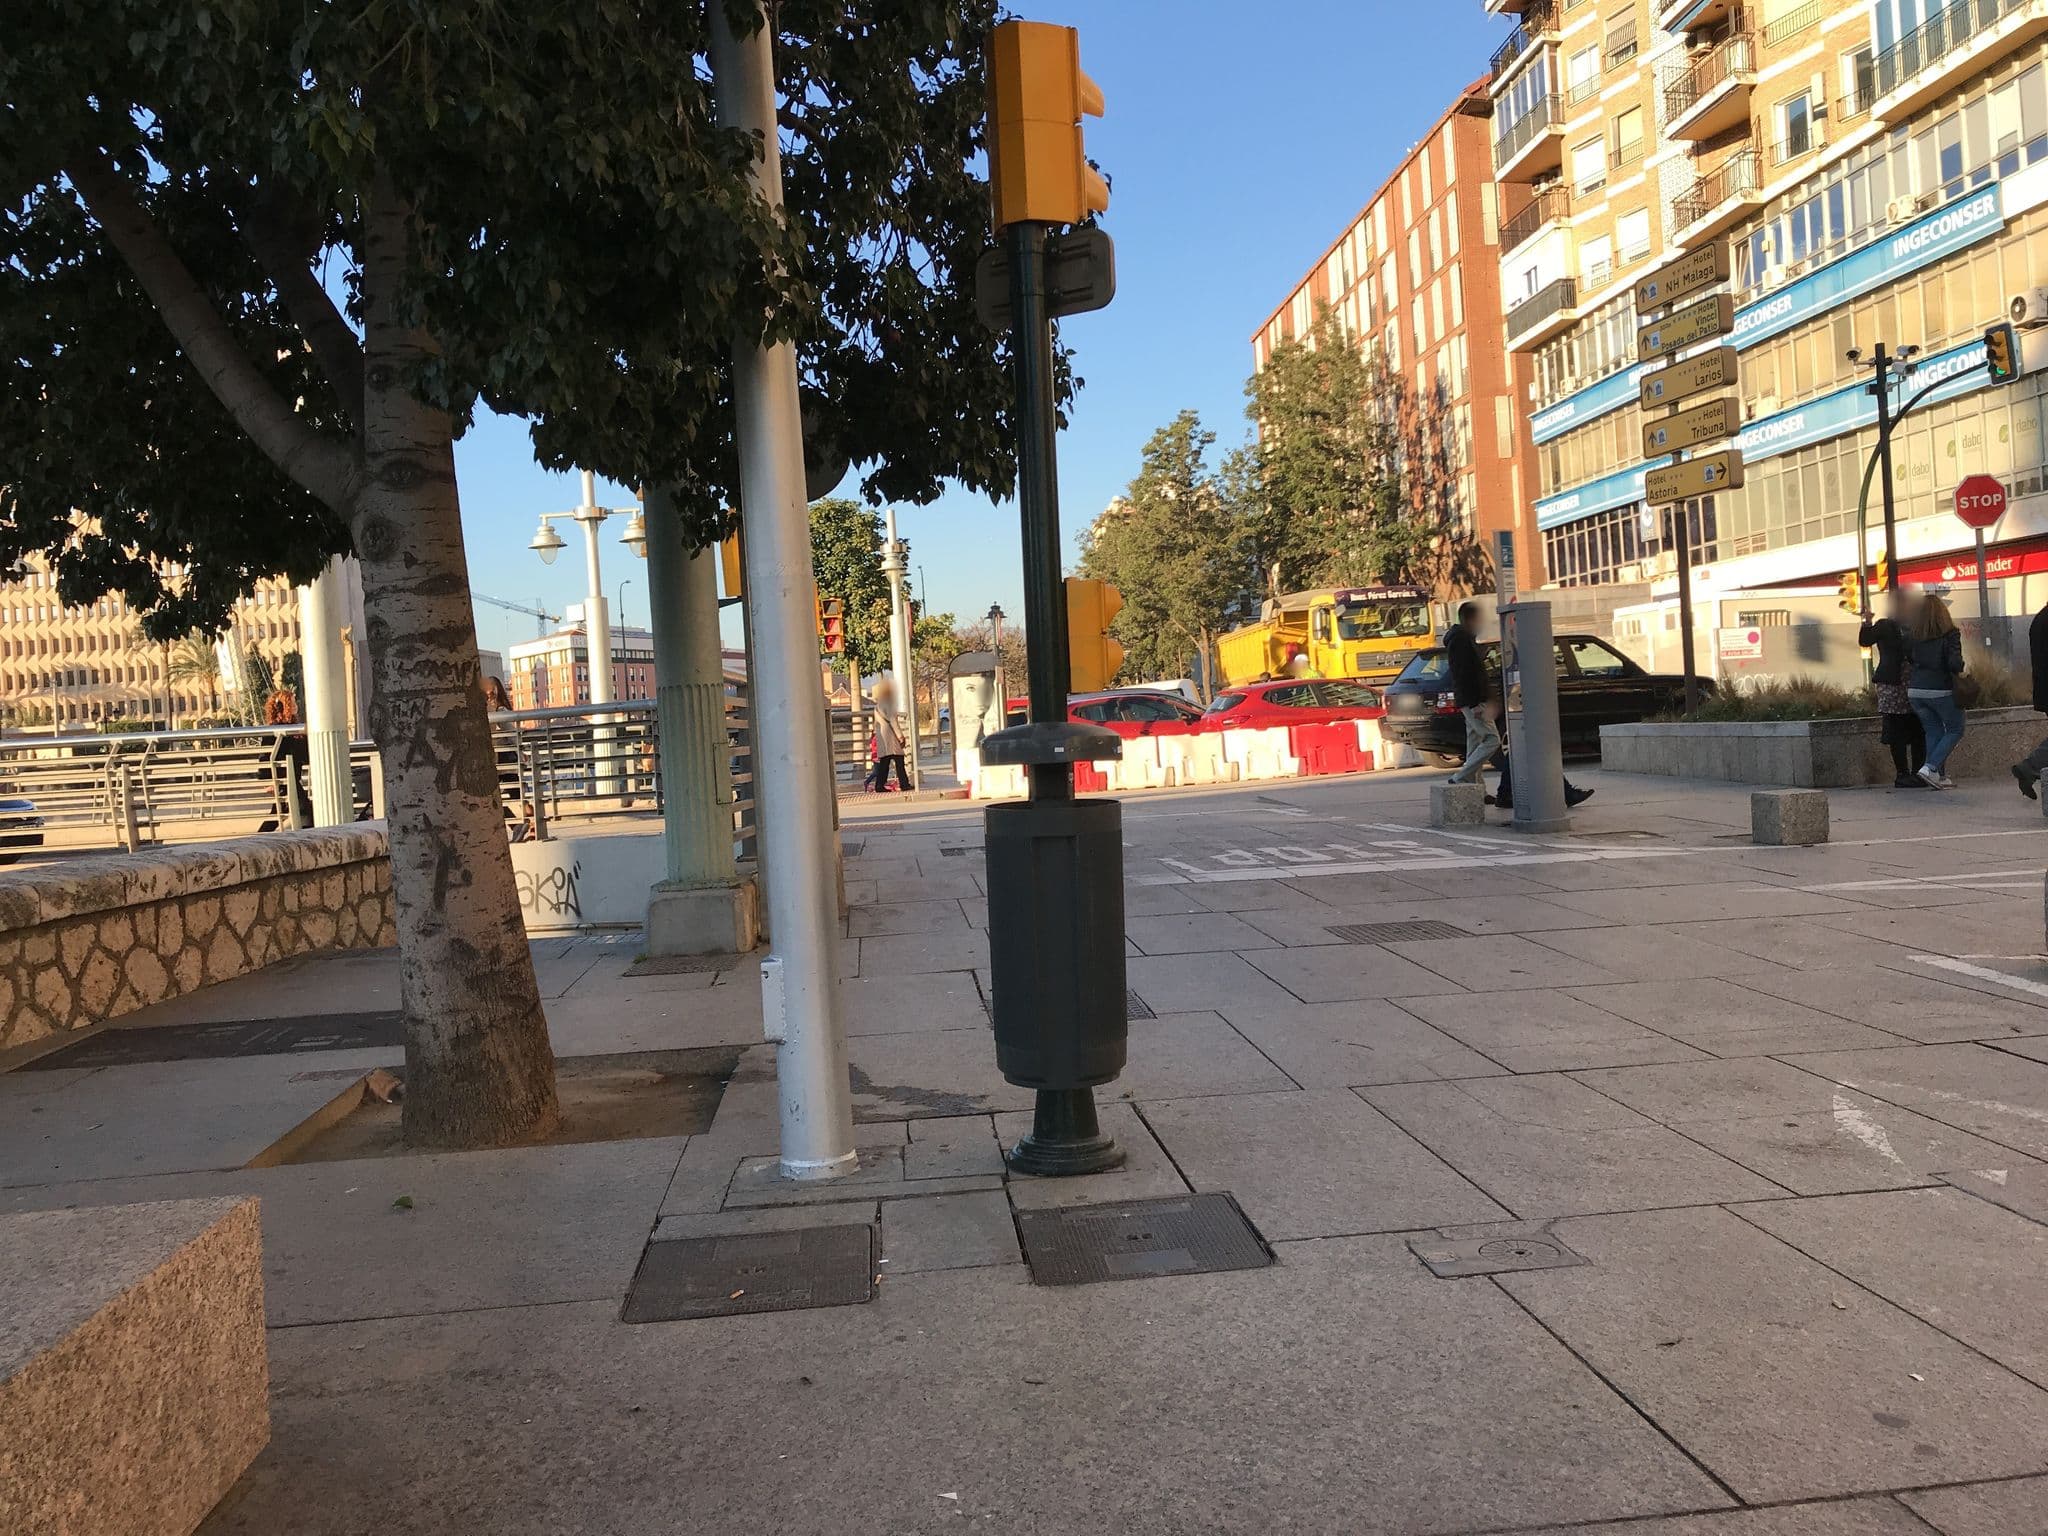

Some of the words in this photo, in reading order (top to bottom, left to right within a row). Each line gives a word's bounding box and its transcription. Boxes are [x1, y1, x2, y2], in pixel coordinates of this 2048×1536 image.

[1893, 193, 1996, 259] INGECONSER
[1693, 249, 1714, 265] Hotel
[1666, 280, 1680, 294] NH
[1698, 301, 1716, 314] Hotel
[1695, 312, 1717, 327] Vincci
[1722, 294, 1793, 342] GECONSER
[1661, 336, 1685, 351] Posada
[1687, 331, 1698, 341] del
[1699, 323, 1718, 336] Patio
[1700, 354, 1721, 370] Hotel
[1695, 369, 1722, 387] Larios
[1703, 405, 1724, 420] Hotel
[1691, 421, 1725, 440] Tribuna
[1911, 462, 1930, 477] dabo
[1648, 473, 1667, 486] Hotel
[1649, 485, 1678, 500] Astoria
[1959, 494, 2002, 509] STOP
[1957, 557, 2013, 578] Sannder
